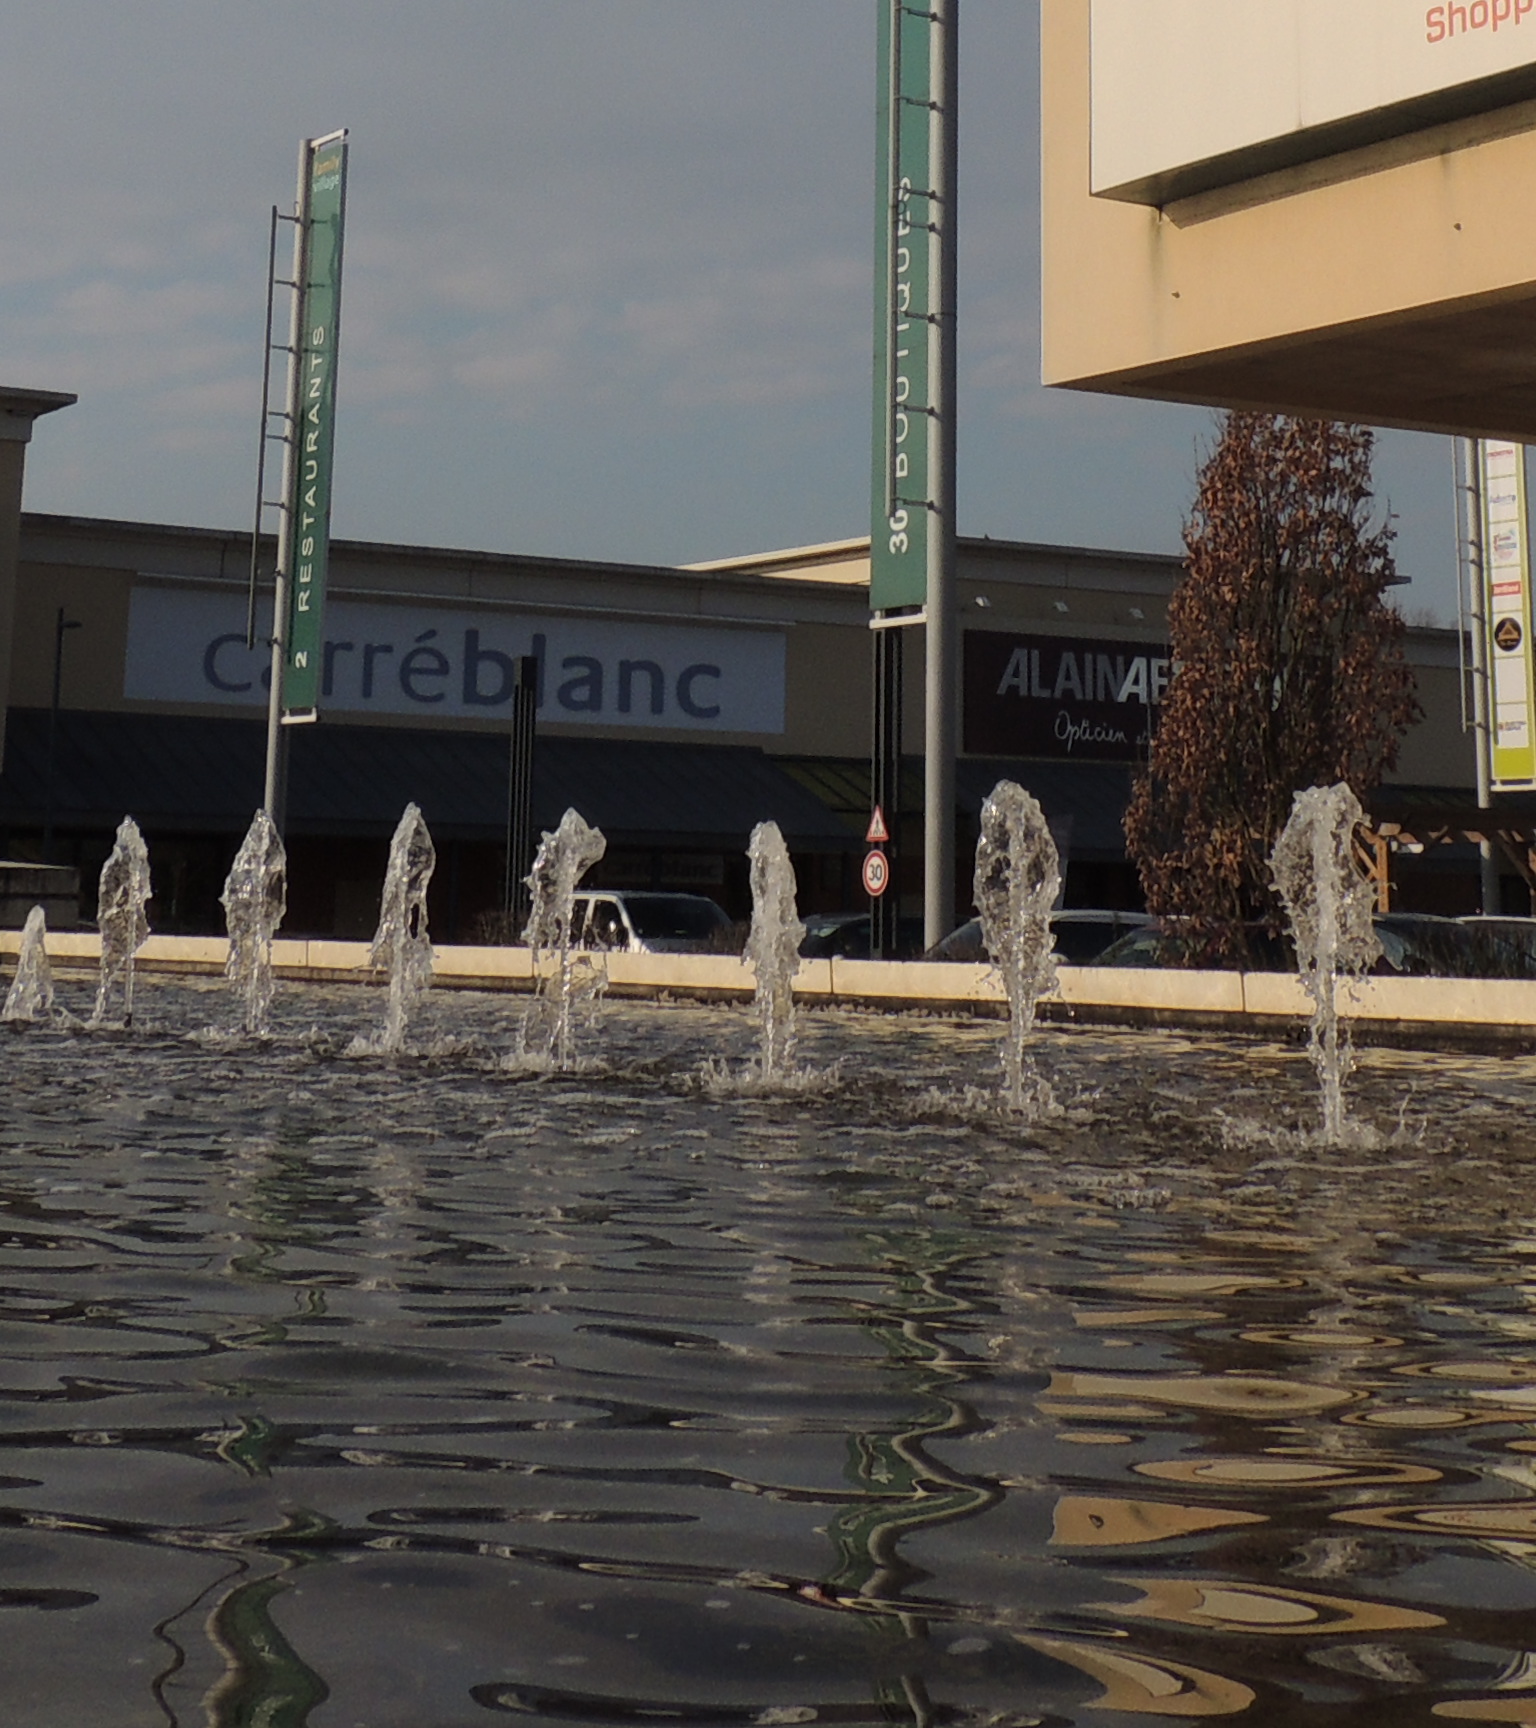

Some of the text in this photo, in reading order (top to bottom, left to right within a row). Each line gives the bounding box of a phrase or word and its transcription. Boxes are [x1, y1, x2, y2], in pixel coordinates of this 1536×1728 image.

[294, 325, 324, 669] 2 RESTAURANTS
[202, 628, 722, 719] crréblanc
[1054, 710, 1129, 753] Opticien
[868, 863, 883, 882] 30
